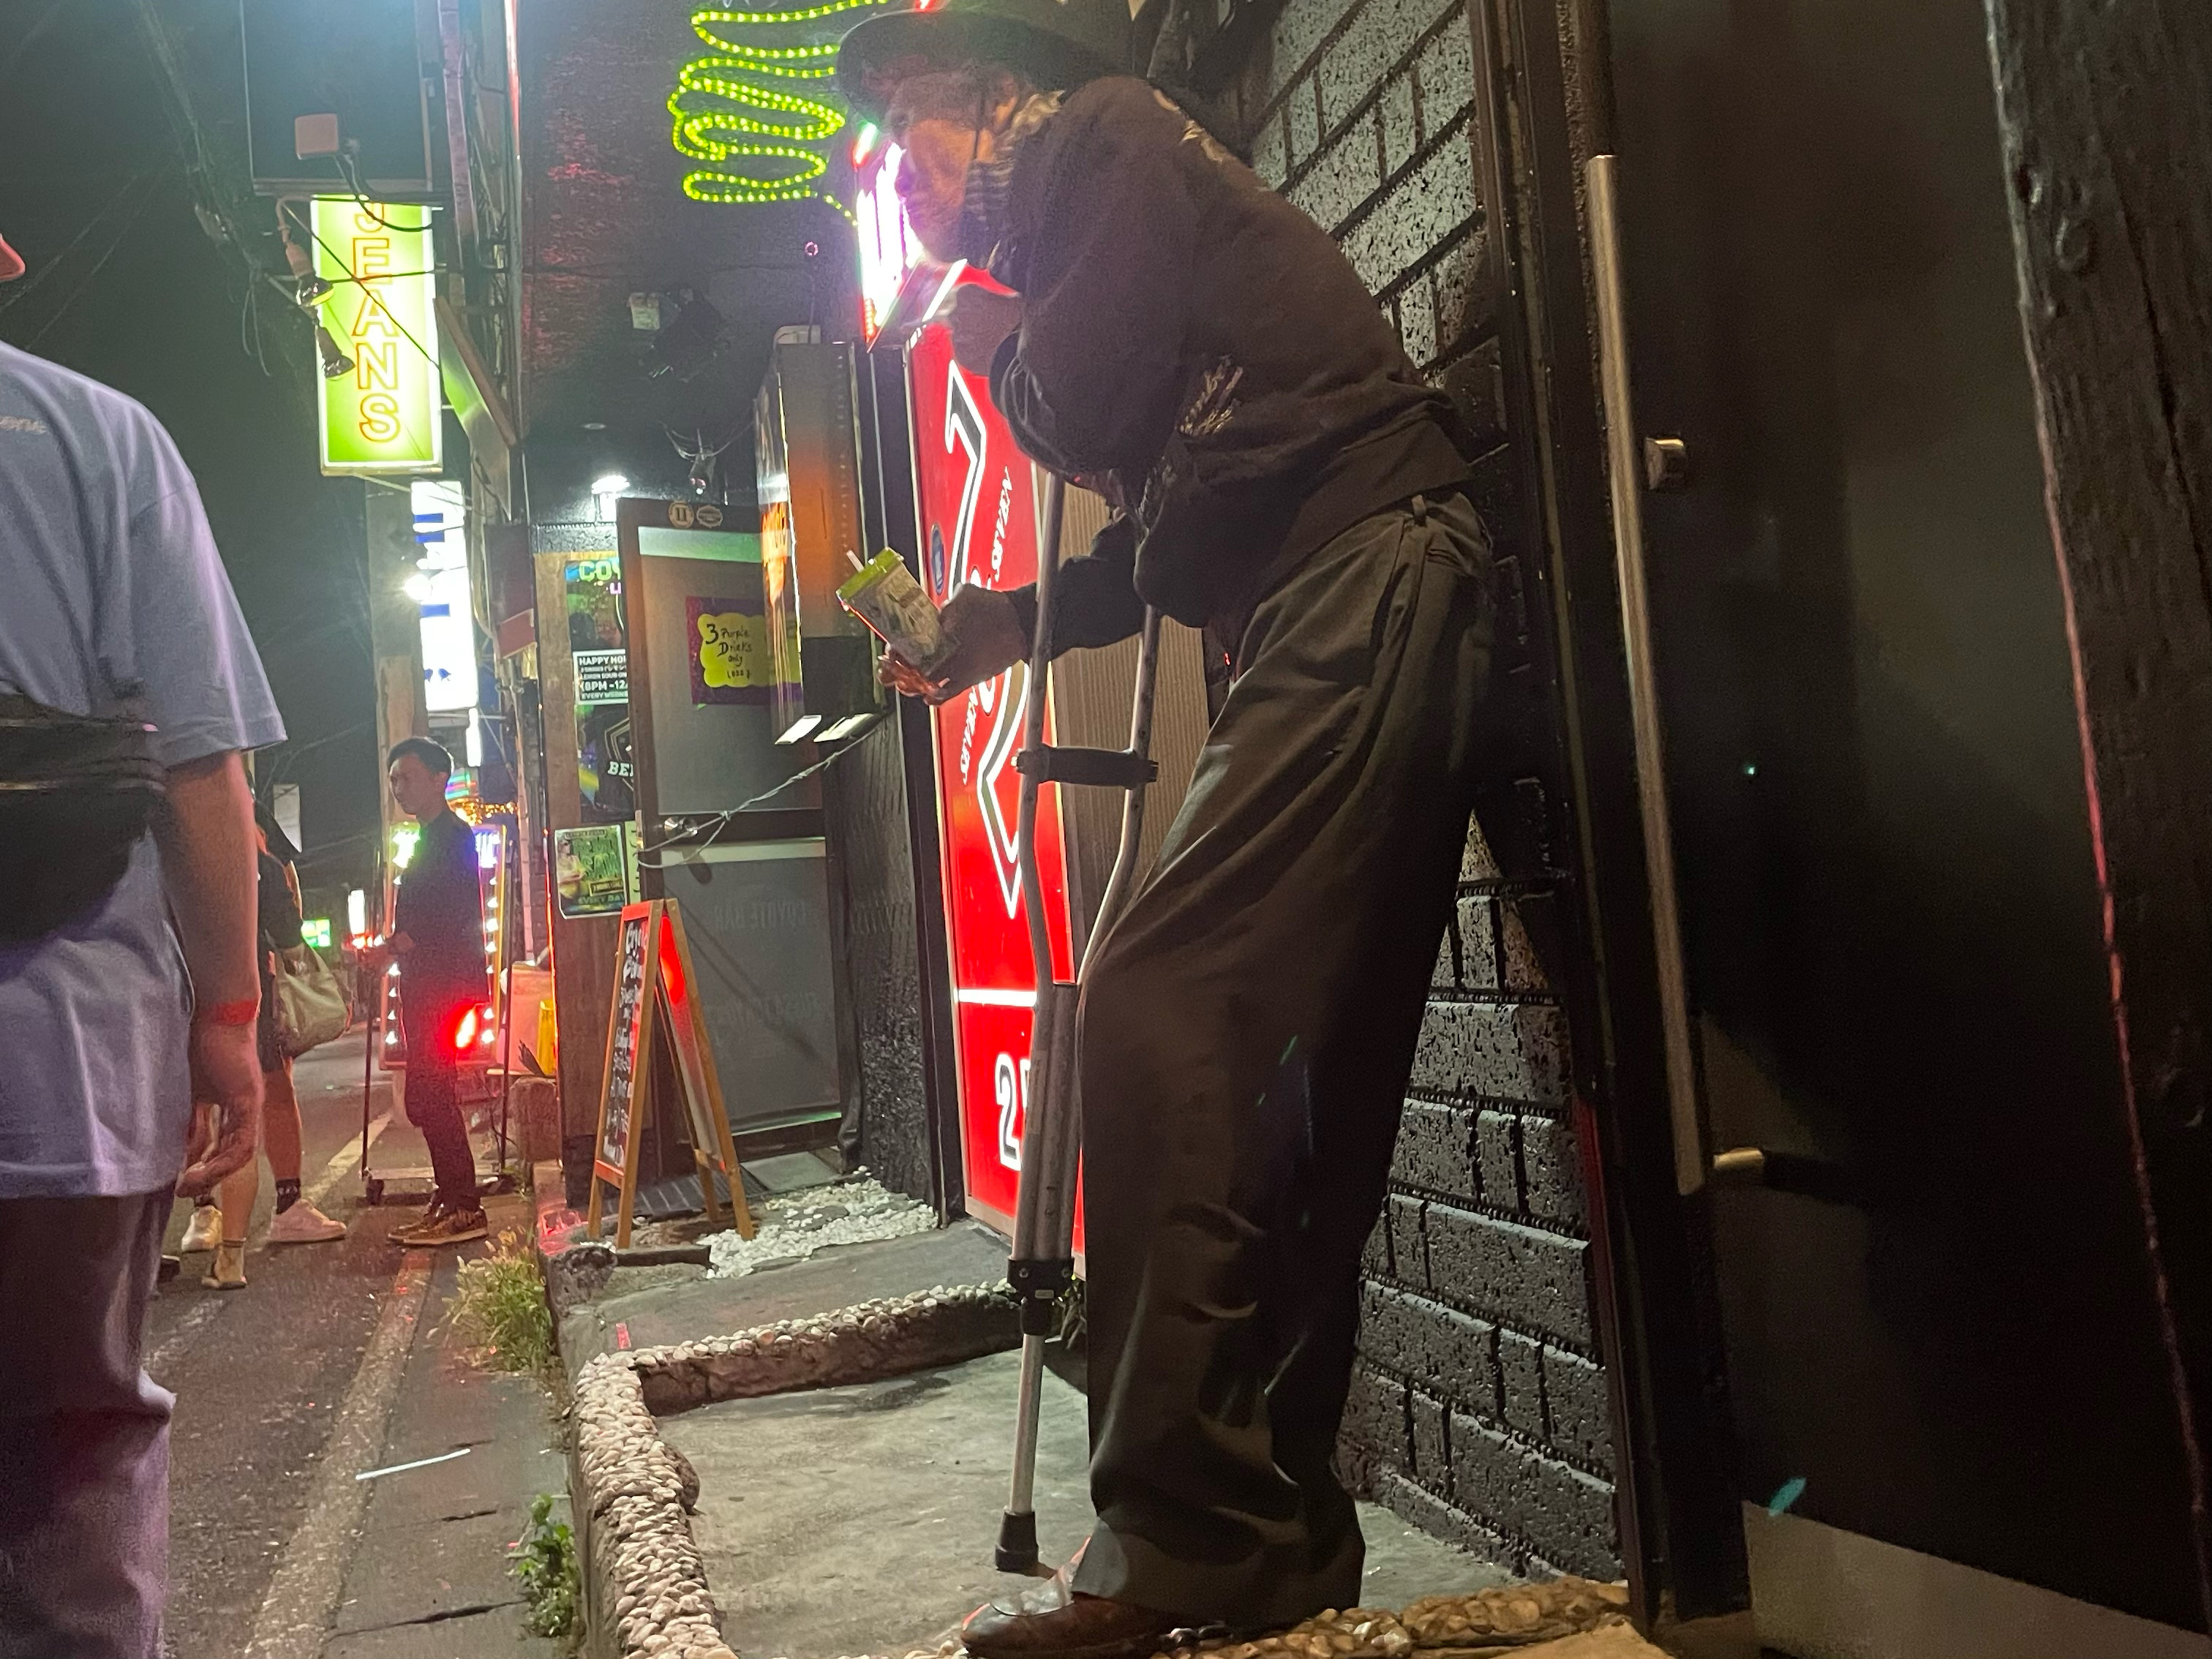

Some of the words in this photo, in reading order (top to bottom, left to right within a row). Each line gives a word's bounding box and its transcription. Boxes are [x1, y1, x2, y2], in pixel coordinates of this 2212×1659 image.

[991, 465, 1013, 583] SEVEN
[579, 656, 610, 666] HAPPY
[705, 623, 719, 645] 3
[960, 685, 979, 786] SEVEN
